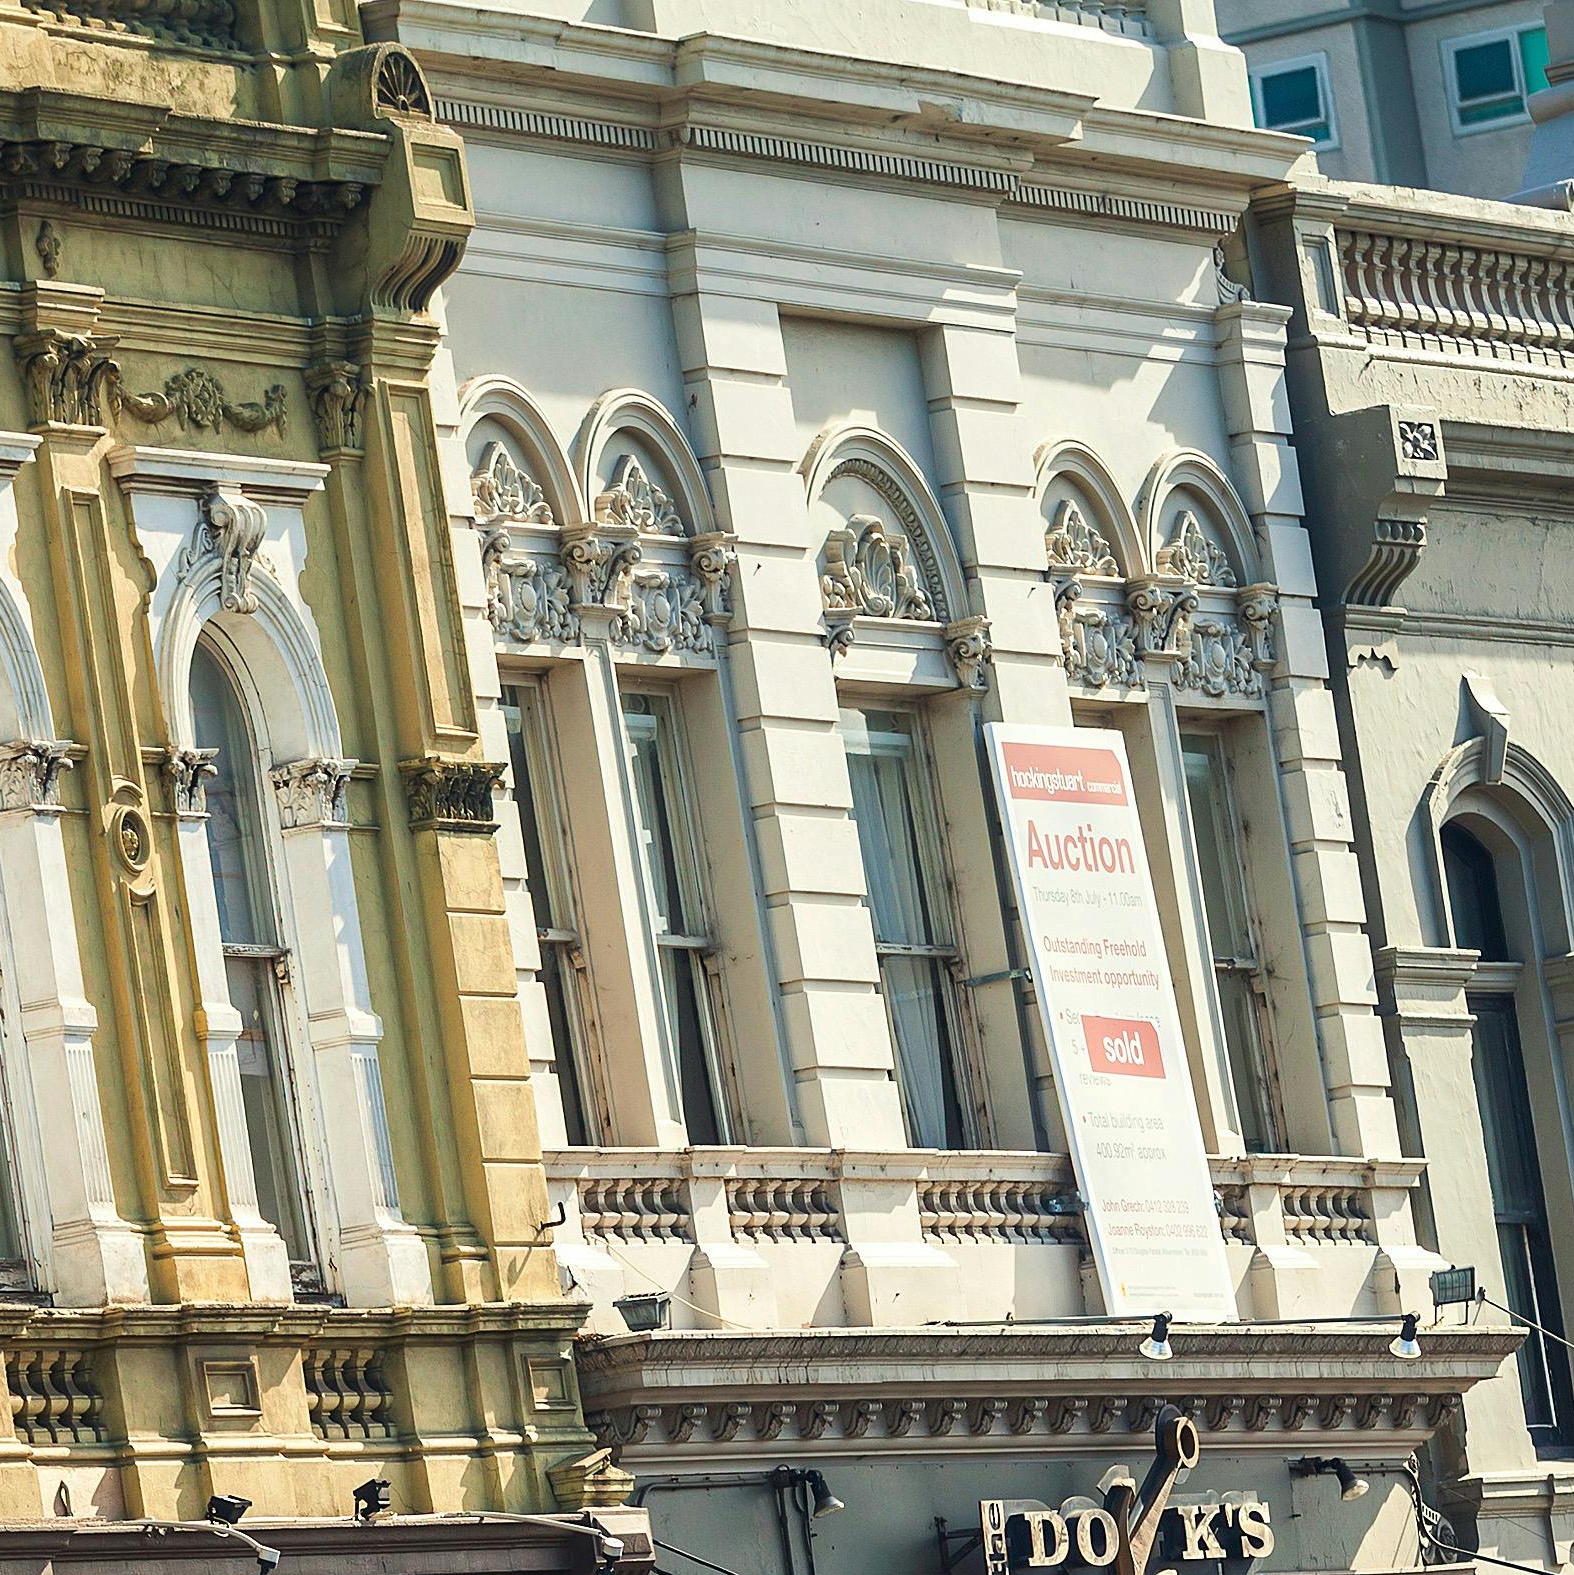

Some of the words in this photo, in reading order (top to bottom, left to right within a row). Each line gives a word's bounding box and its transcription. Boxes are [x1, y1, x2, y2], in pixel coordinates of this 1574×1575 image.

[1010, 765, 1086, 795] hockingstuart
[1087, 781, 1123, 794] commercial
[1027, 819, 1136, 874] Auction
[1032, 886, 1069, 907] Thursday
[1086, 889, 1101, 908] July
[1043, 935, 1102, 959] Outstanding
[1103, 938, 1147, 957] Freehold
[1049, 965, 1103, 985] Investment
[1104, 969, 1159, 990] opportunity
[1102, 1030, 1145, 1066] sold
[1079, 1073, 1113, 1086] reviews
[1088, 1111, 1110, 1129] Total
[1111, 1112, 1146, 1134] building
[1146, 1117, 1164, 1130] area
[1136, 1146, 1168, 1164] approx
[1101, 1199, 1120, 1213] John
[1108, 1223, 1134, 1237] Joanne
